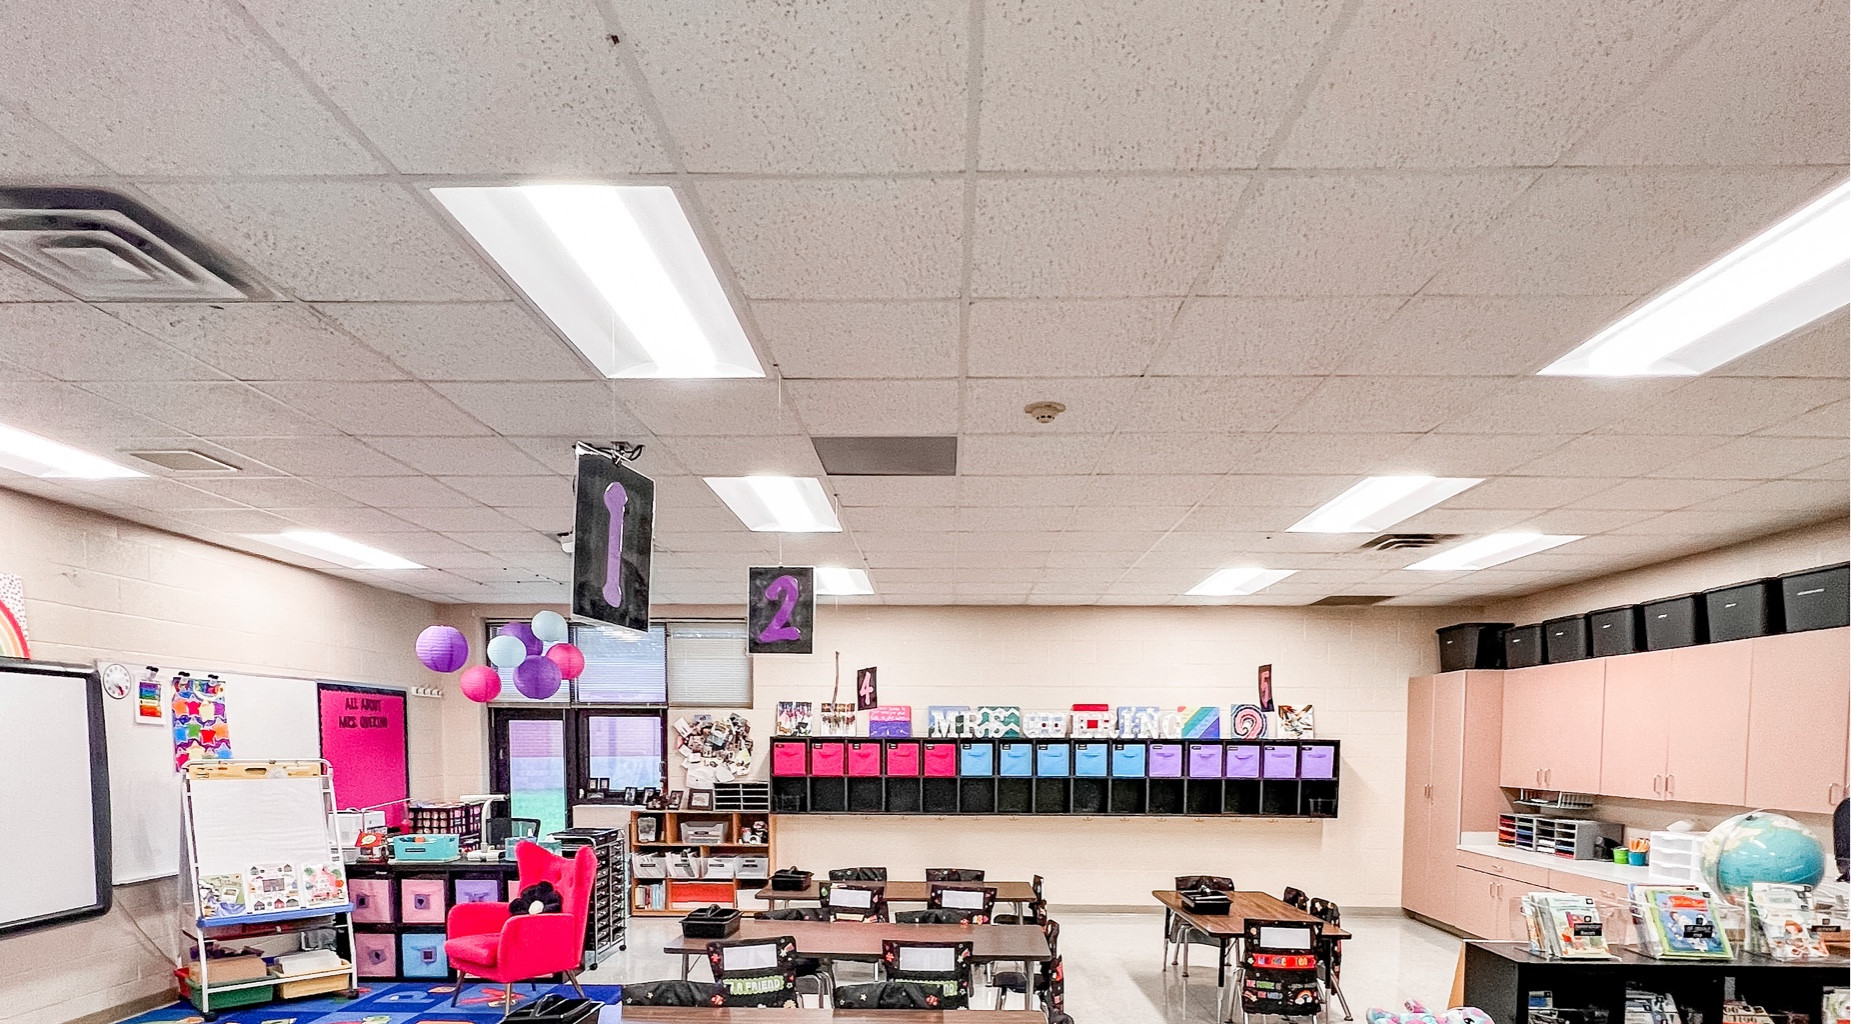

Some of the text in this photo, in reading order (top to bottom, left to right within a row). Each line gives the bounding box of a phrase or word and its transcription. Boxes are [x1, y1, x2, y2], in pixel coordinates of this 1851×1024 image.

[758, 575, 801, 643] 2
[859, 671, 874, 705] 4
[744, 978, 780, 992] FRIEND
